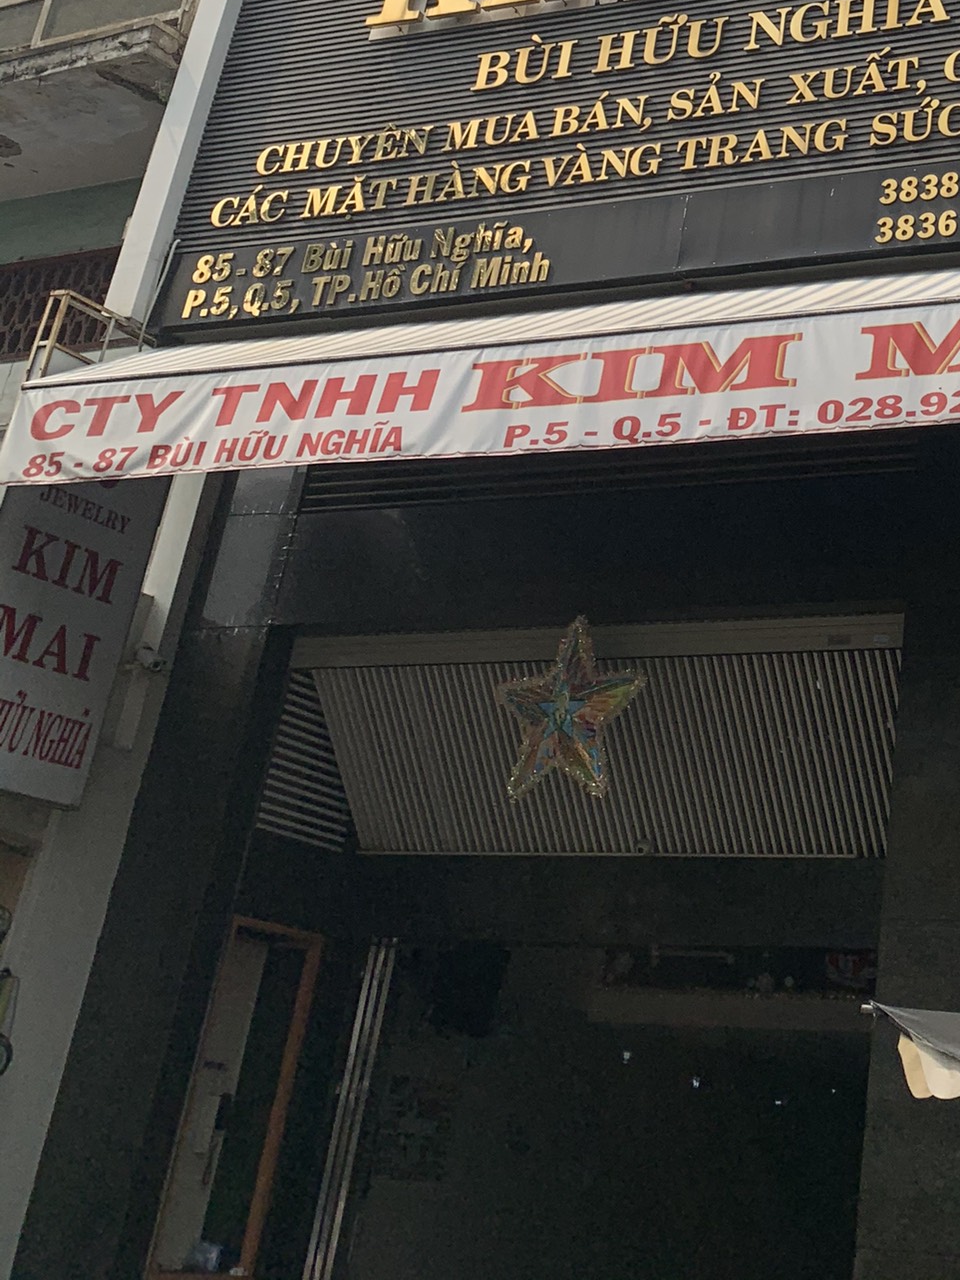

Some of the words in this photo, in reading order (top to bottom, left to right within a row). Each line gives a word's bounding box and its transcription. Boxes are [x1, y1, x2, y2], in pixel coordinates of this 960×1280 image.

[470, 33, 579, 92] BÙI
[591, 13, 730, 74] HỮU
[256, 122, 434, 176] CHUYÊN
[441, 110, 540, 153] MUA
[549, 91, 653, 138] BÁN,
[667, 71, 762, 122] SẢN
[785, 46, 929, 105] XUẤT,
[210, 183, 289, 228] CÁC
[402, 160, 532, 207] HÀNG
[541, 143, 664, 189] VÀNG
[676, 119, 848, 172] TRANG
[879, 170, 960, 205] 3838
[874, 208, 958, 245] 3836
[300, 239, 356, 274] Bùi
[361, 232, 423, 266] Hữu
[409, 261, 466, 296] Chí
[470, 251, 551, 290] Minh
[30, 390, 185, 442] CTY
[211, 368, 441, 428] TNHH
[461, 332, 803, 413] KIM
[145, 436, 207, 471] BÙI
[214, 429, 288, 464] HỮU
[295, 421, 403, 458] NGHĨA
[503, 420, 569, 448] P.5
[612, 412, 683, 445] Q.5
[727, 403, 800, 431] ĐT:
[40, 487, 132, 535] JEWELRY
[11, 523, 125, 605] KIM
[0, 603, 101, 683] MAI
